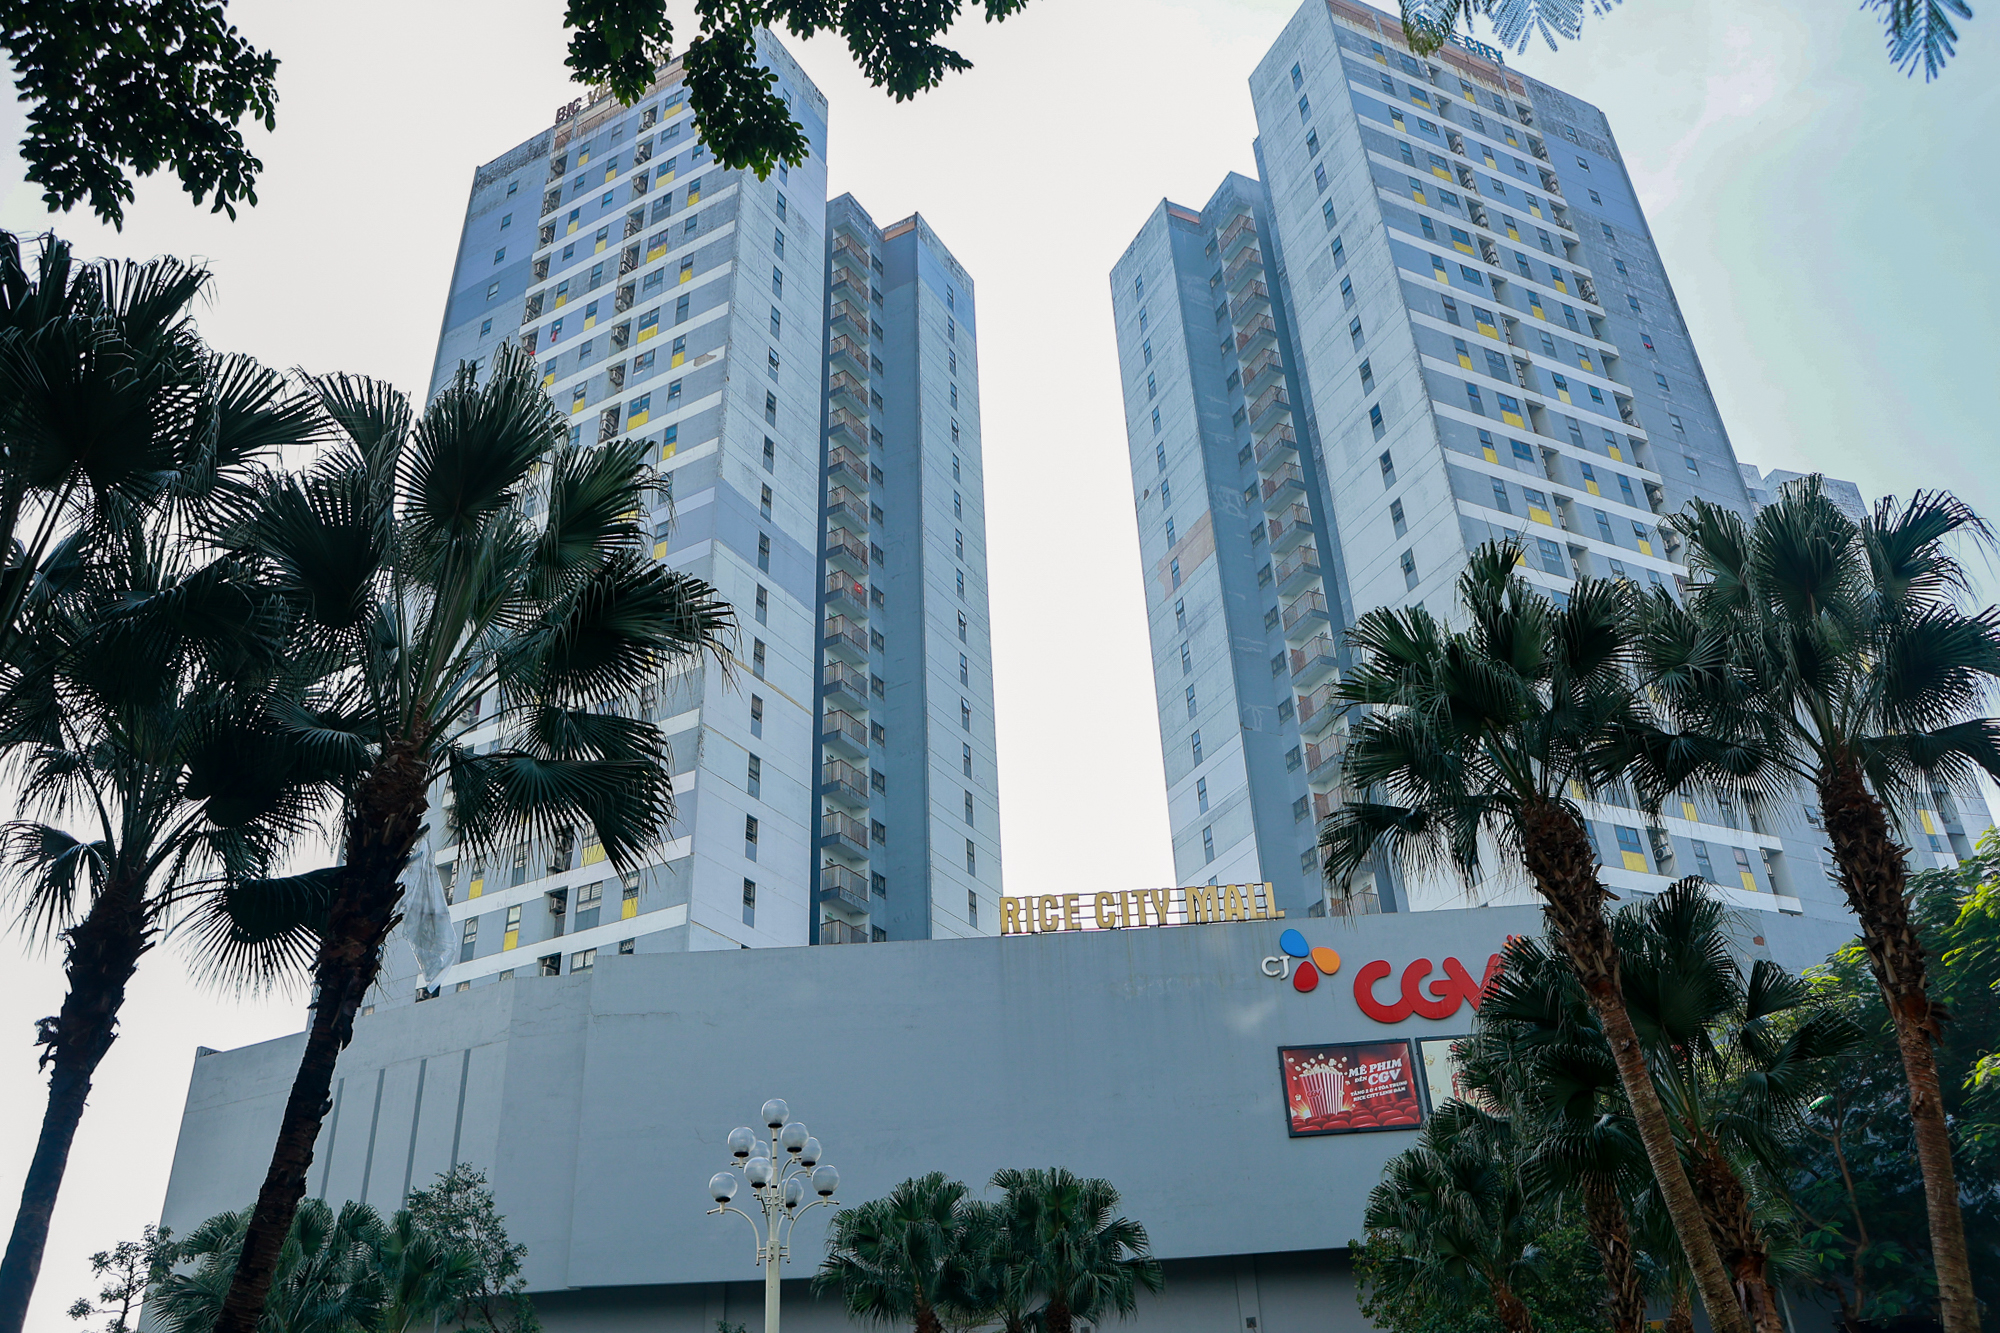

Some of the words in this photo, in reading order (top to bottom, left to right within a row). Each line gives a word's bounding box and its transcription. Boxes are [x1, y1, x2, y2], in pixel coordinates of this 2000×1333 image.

[1465, 35, 1504, 65] CITY
[1000, 893, 1081, 934] RICE
[1095, 887, 1170, 930] CITY
[1184, 881, 1286, 925] MALL
[1261, 955, 1291, 980] CJ
[1353, 953, 1504, 1024] CGV
[1348, 1064, 1368, 1078] MÊ
[1369, 1058, 1403, 1074] PHIM
[1368, 1068, 1402, 1086] CGV
